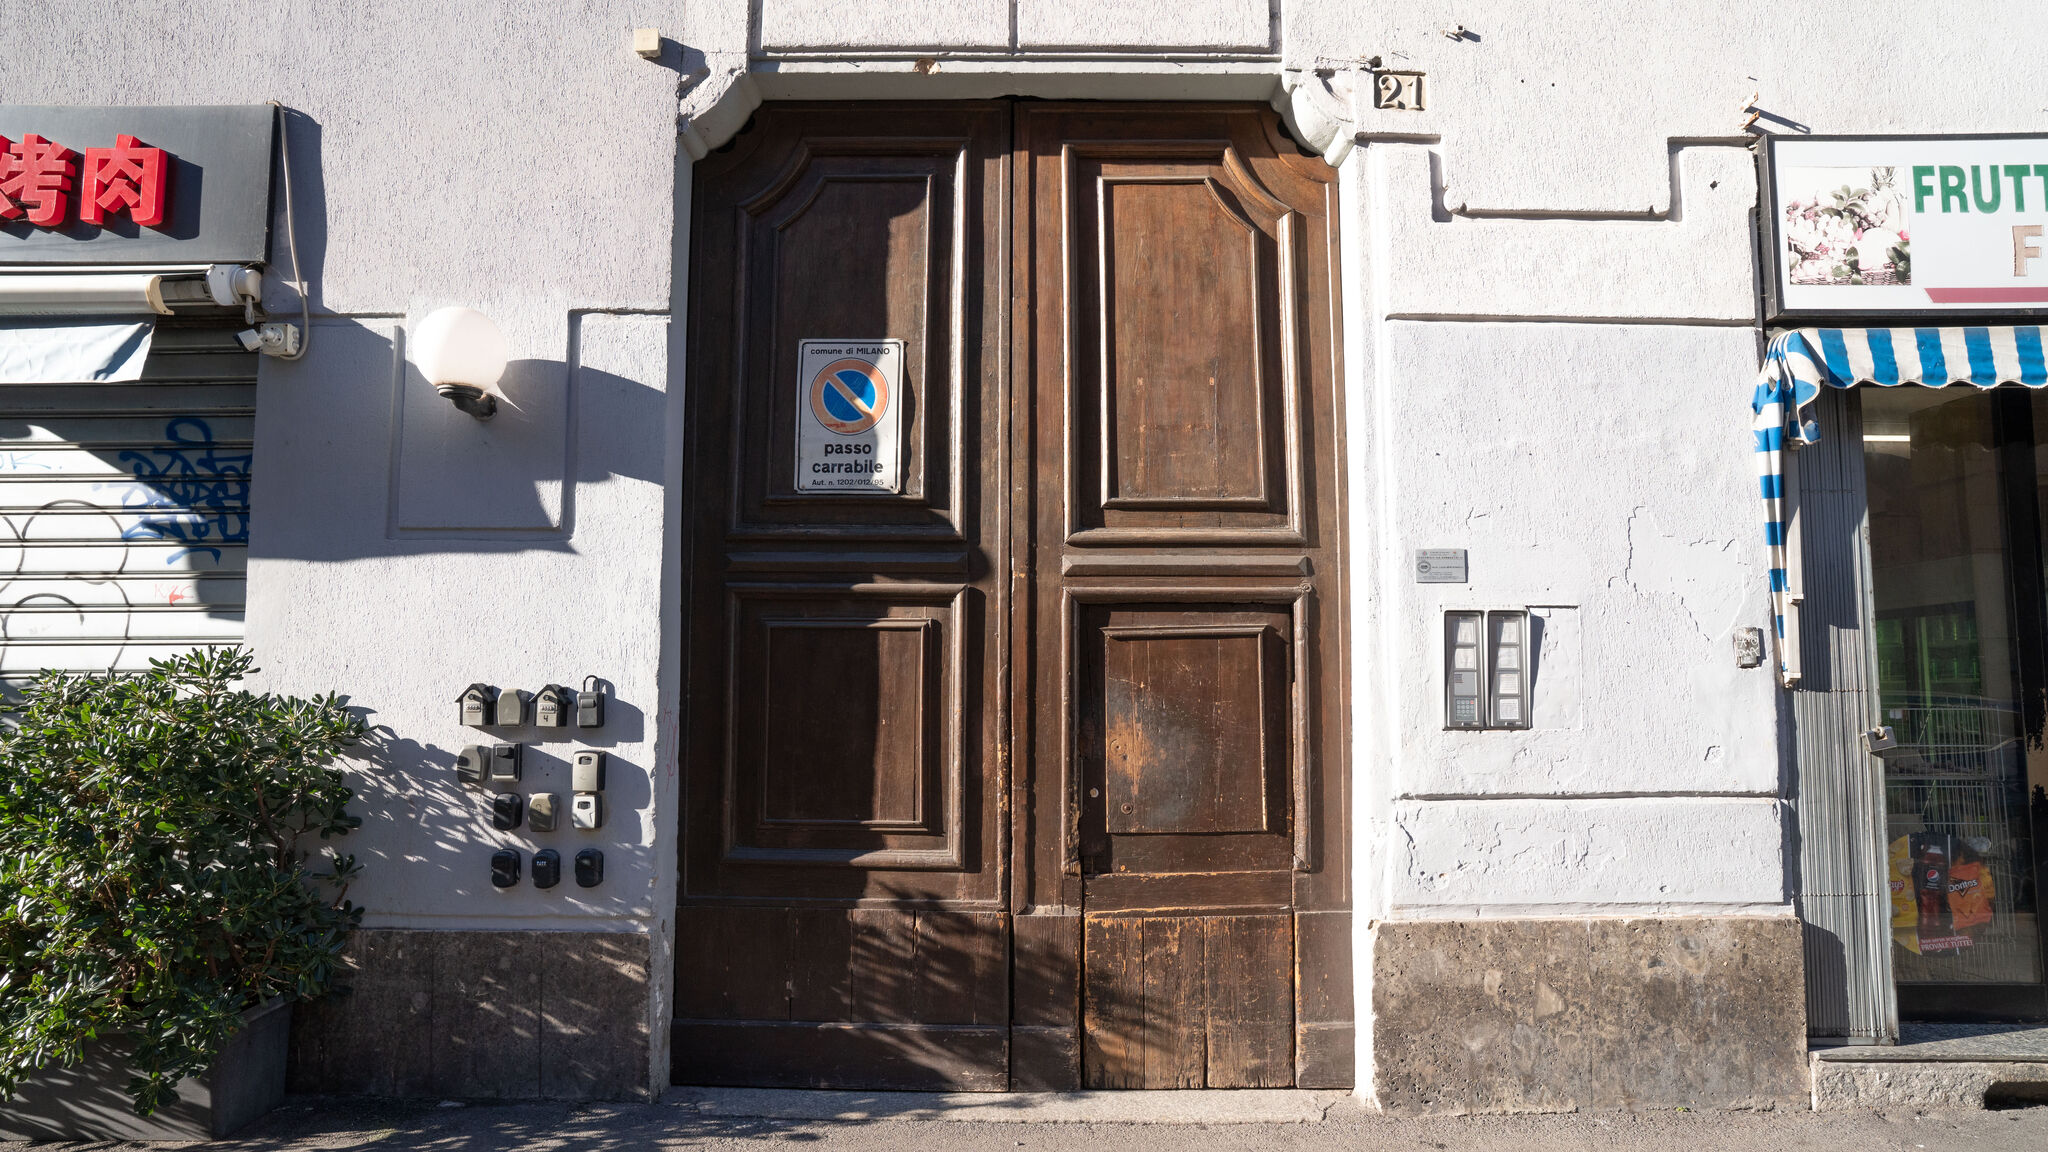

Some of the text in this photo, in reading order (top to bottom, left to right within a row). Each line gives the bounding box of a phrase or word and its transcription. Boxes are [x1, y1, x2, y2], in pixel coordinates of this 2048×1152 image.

[1378, 74, 1424, 110] 21
[2012, 224, 2044, 277] F
[845, 347, 854, 355] di
[856, 347, 890, 355] MILANO
[824, 443, 872, 456] passo
[812, 460, 884, 474] carrabile
[1948, 879, 1978, 892] Doritos
